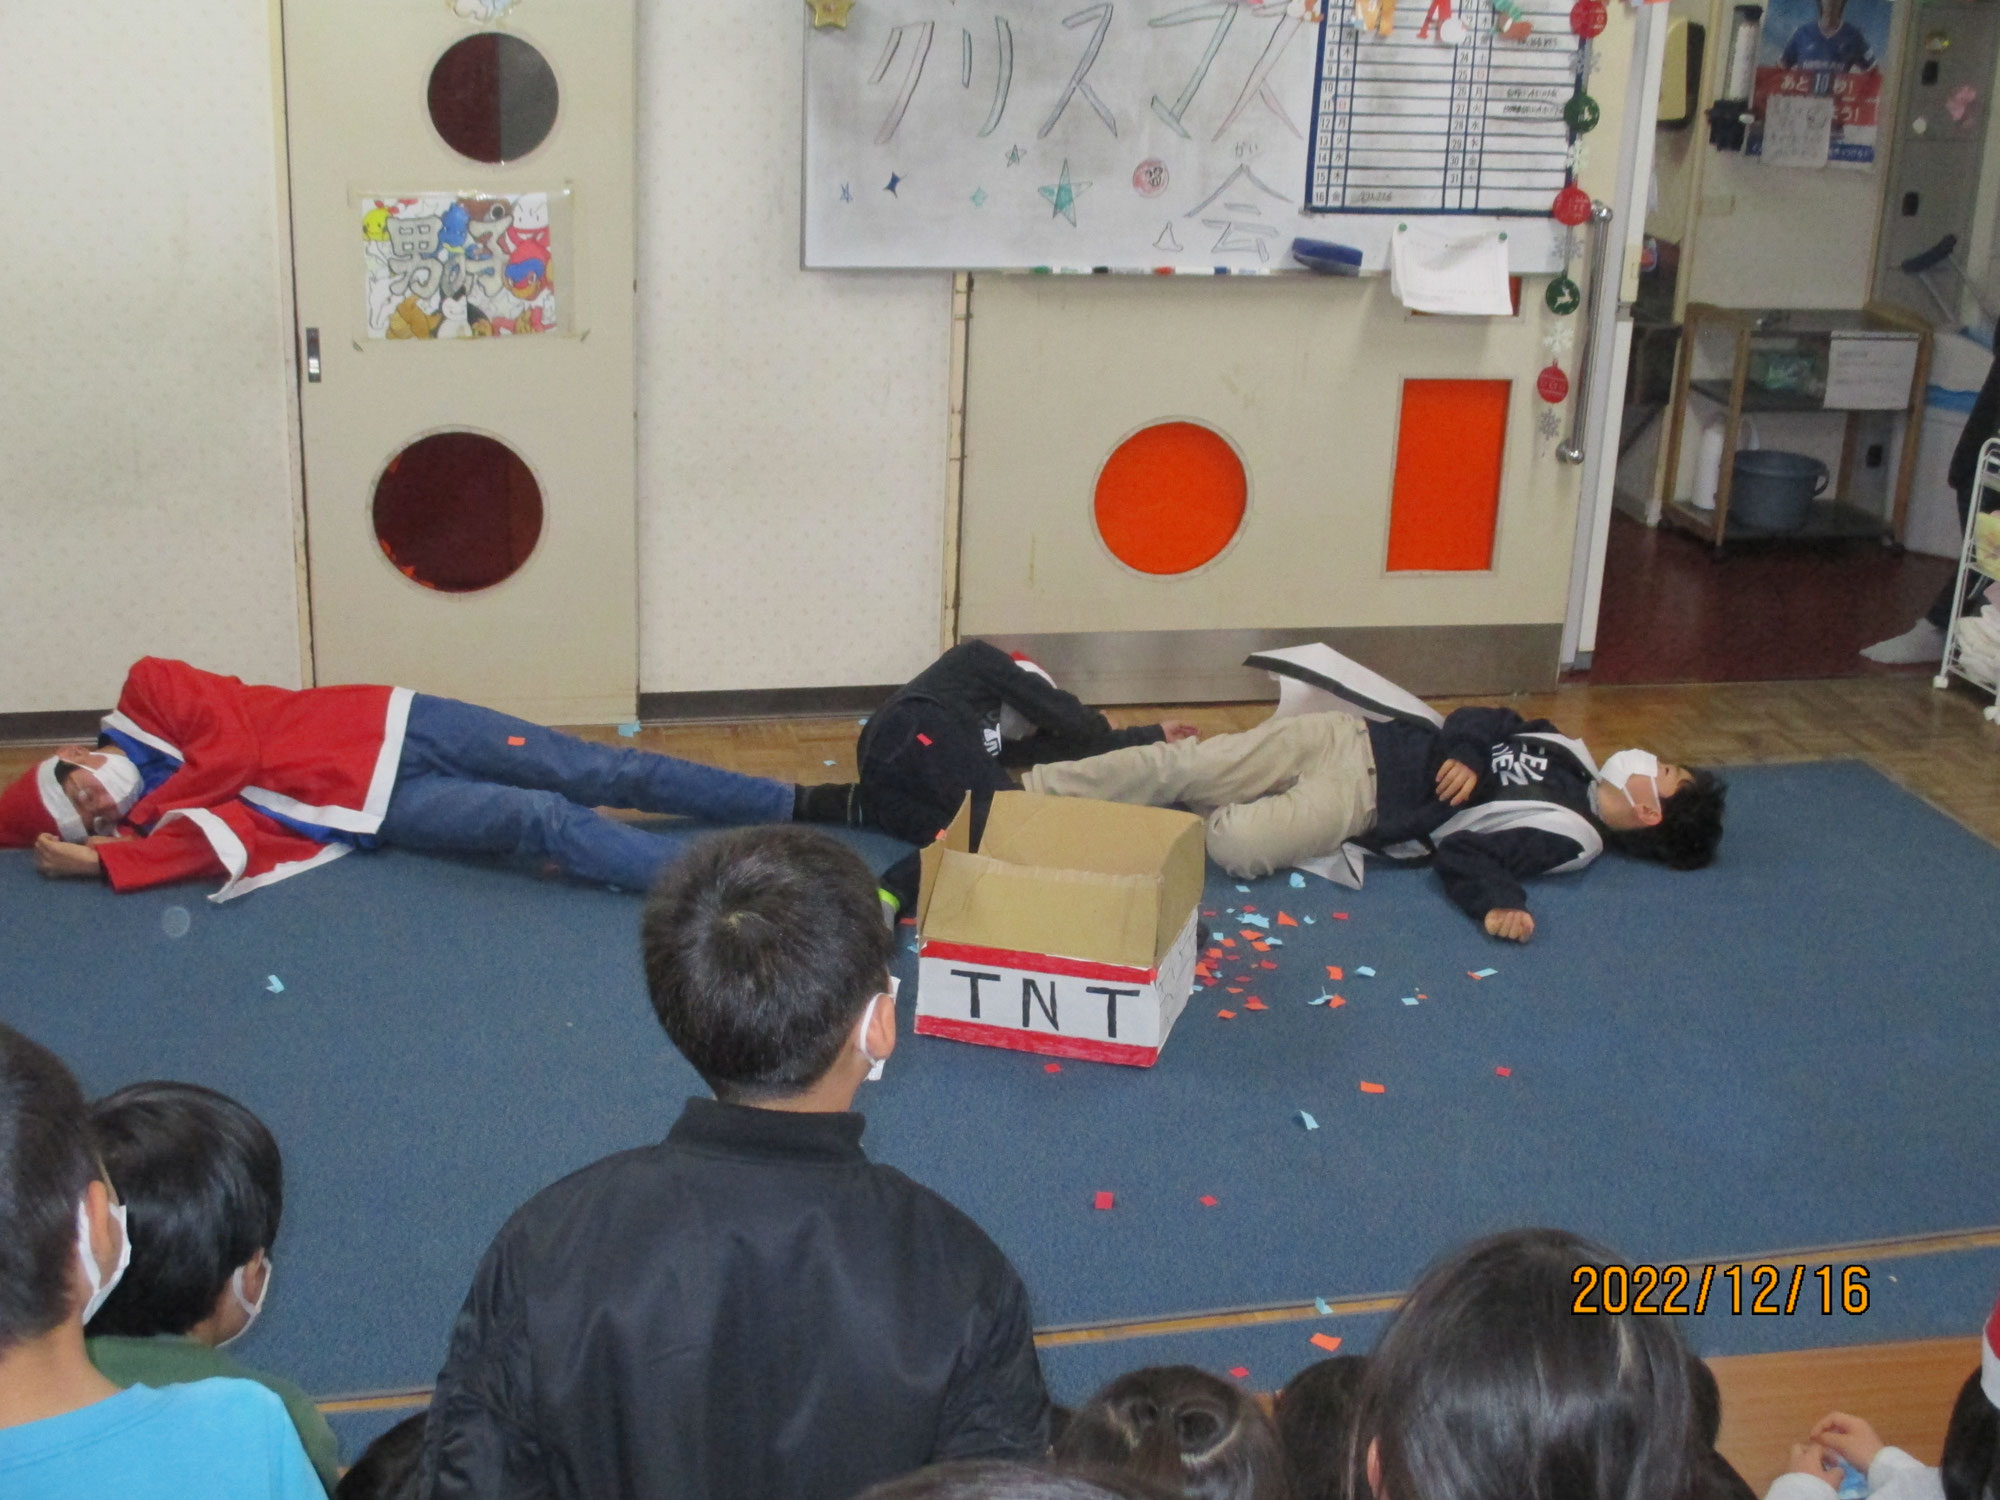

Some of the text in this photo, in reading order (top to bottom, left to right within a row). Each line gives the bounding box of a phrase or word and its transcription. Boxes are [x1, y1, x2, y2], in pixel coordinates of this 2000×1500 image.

[868, 2, 1303, 145] クリスマス
[386, 214, 514, 299] 男の子
[1184, 163, 1295, 263] 会
[950, 968, 1141, 1039] TNT
